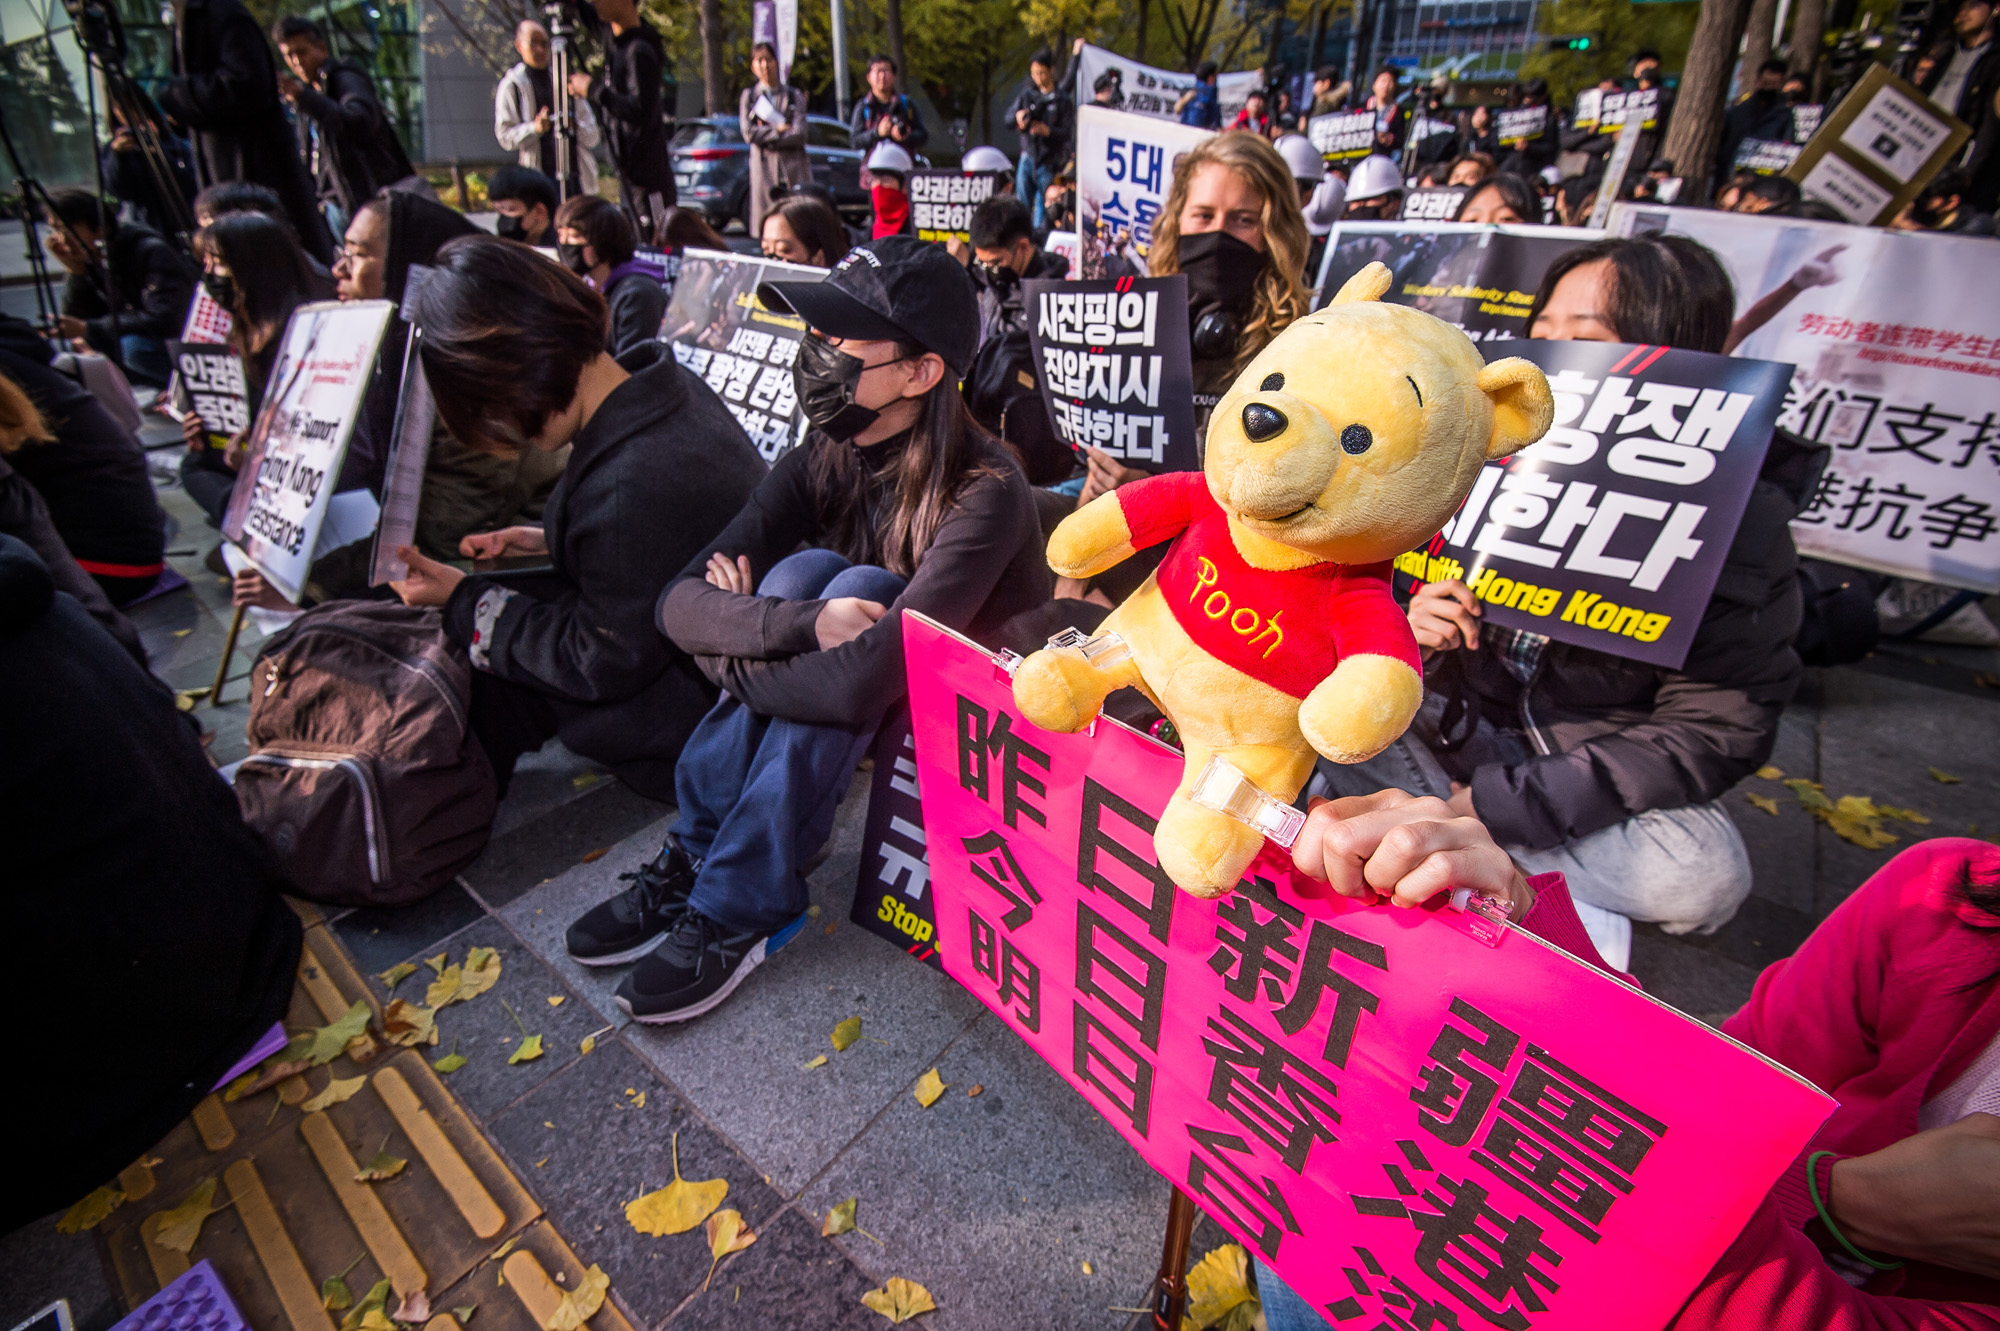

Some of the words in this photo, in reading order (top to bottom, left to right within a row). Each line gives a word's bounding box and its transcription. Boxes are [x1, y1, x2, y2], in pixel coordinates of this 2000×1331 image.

[910, 174, 995, 203] 인권침해
[1106, 136, 1164, 195] 5대
[726, 326, 775, 361] 시진핑
[1037, 291, 1159, 347] 시진핑의
[1042, 346, 1163, 408] 진압지시
[1052, 397, 1170, 464] 규탄한다
[1441, 464, 1708, 593] 한다
[1189, 556, 1284, 660] Pooh
[1466, 567, 1563, 617] Hong
[1559, 589, 1672, 643] Kong
[876, 894, 933, 943] Stop
